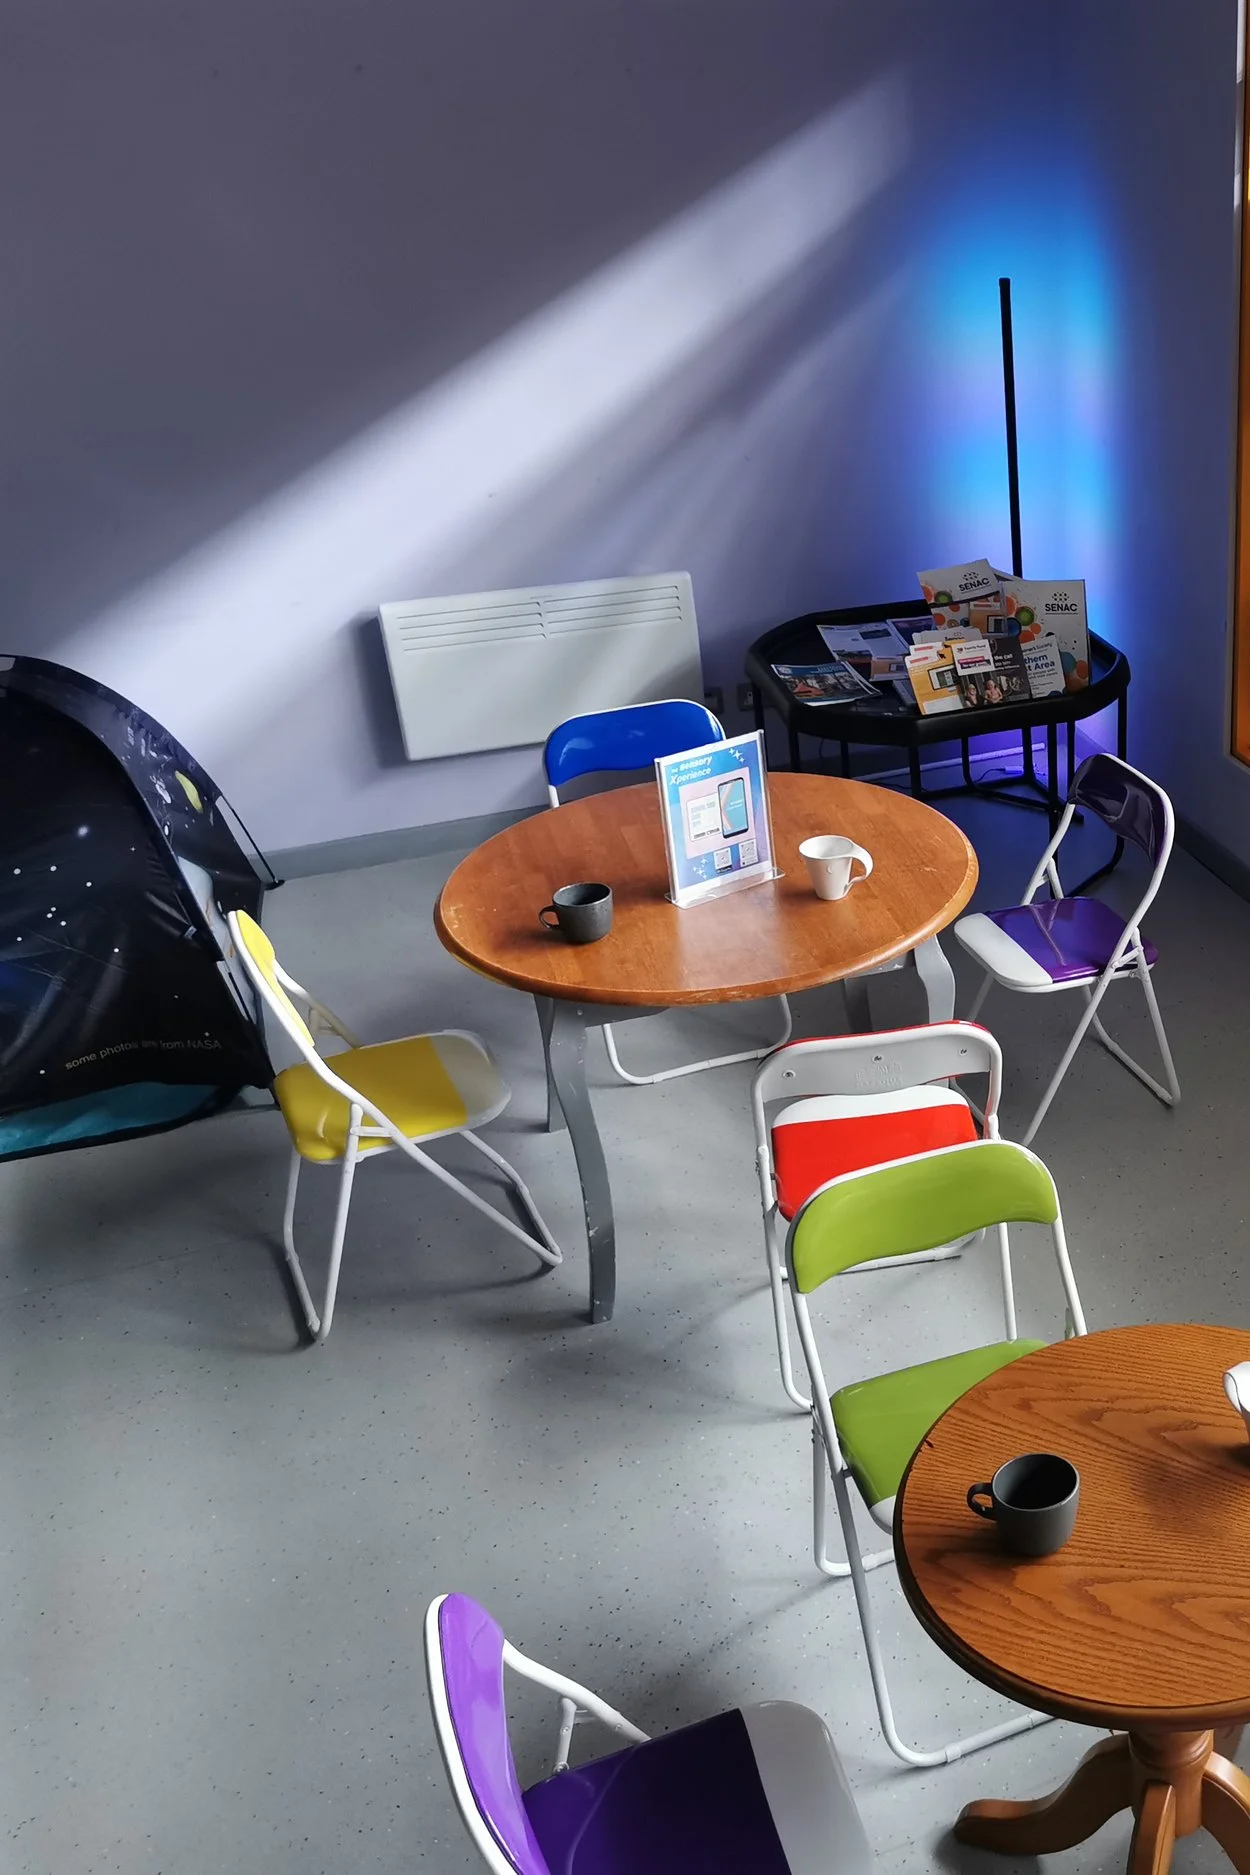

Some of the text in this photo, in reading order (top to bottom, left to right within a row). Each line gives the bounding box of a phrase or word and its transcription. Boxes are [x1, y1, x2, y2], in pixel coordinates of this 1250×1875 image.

[958, 577, 991, 592] SENAC
[1044, 603, 1078, 612] SENAC
[65, 1052, 97, 1071] some
[187, 1039, 222, 1049] NASA
